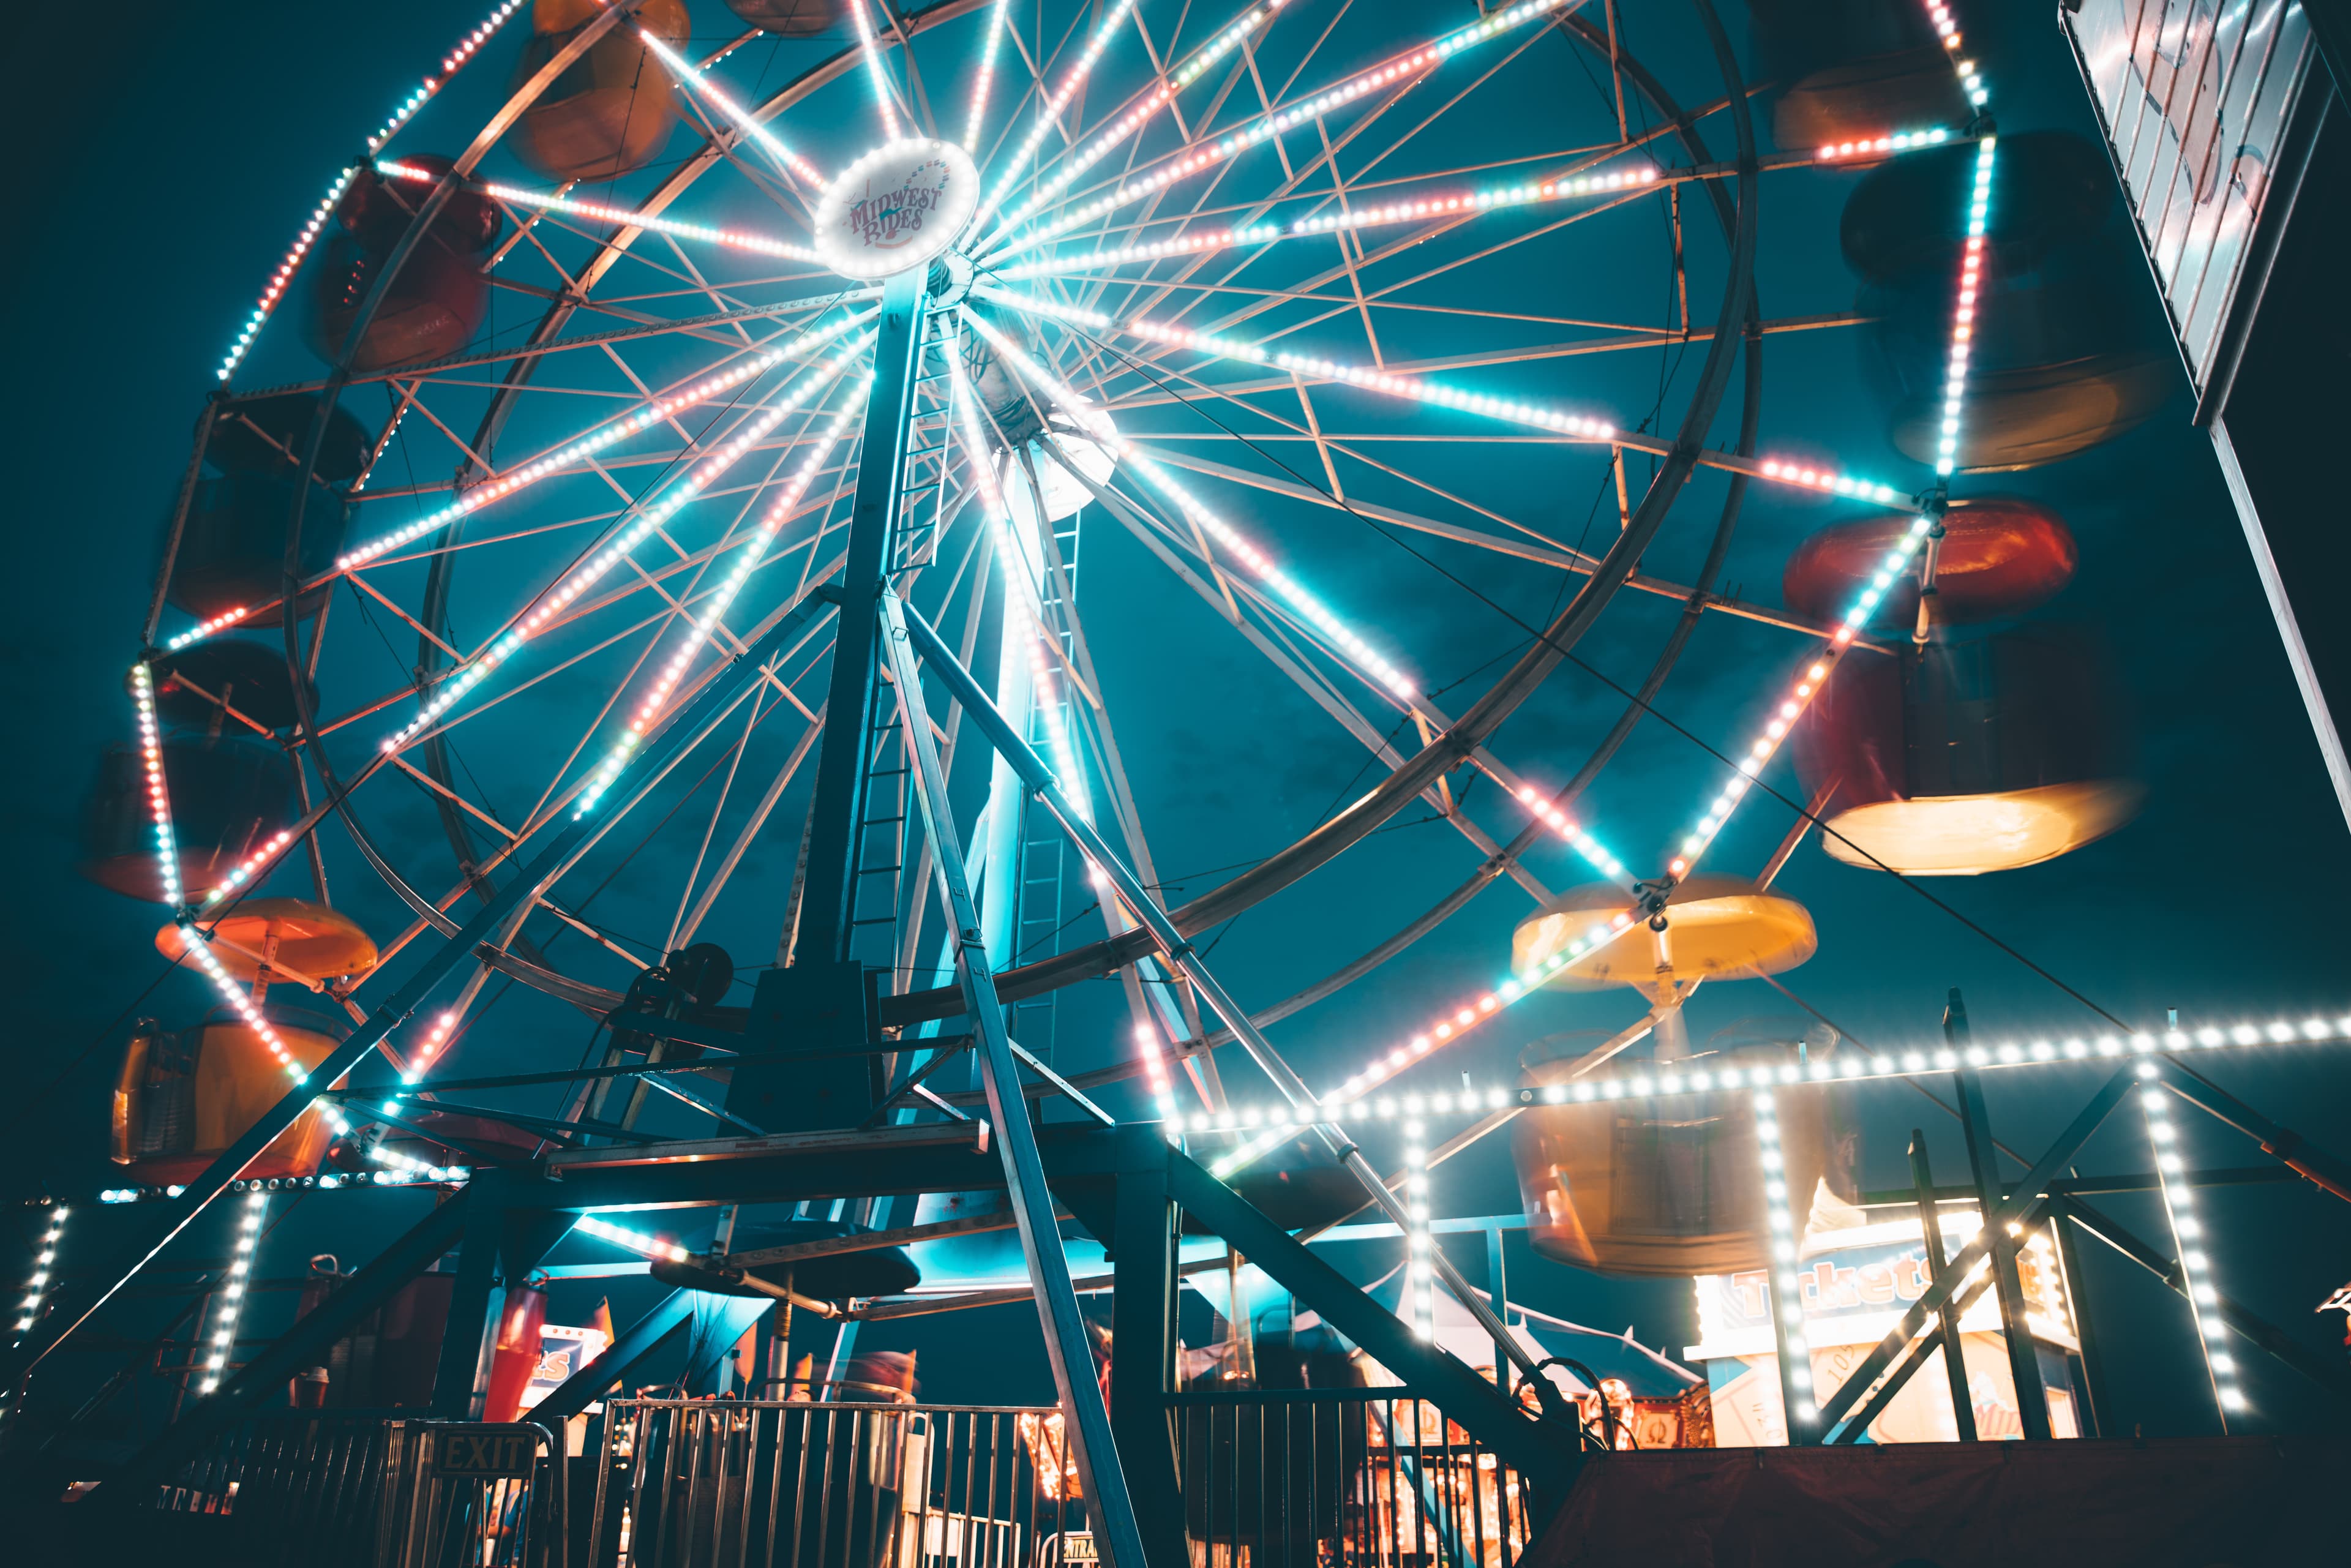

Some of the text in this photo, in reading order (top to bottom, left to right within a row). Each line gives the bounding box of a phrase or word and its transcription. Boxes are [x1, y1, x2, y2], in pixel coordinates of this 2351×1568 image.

[850, 187, 942, 235] MIDWEST
[863, 208, 923, 246] RIDES
[1731, 1252, 1933, 1317] Tcket
[444, 1436, 525, 1470] EXIT
